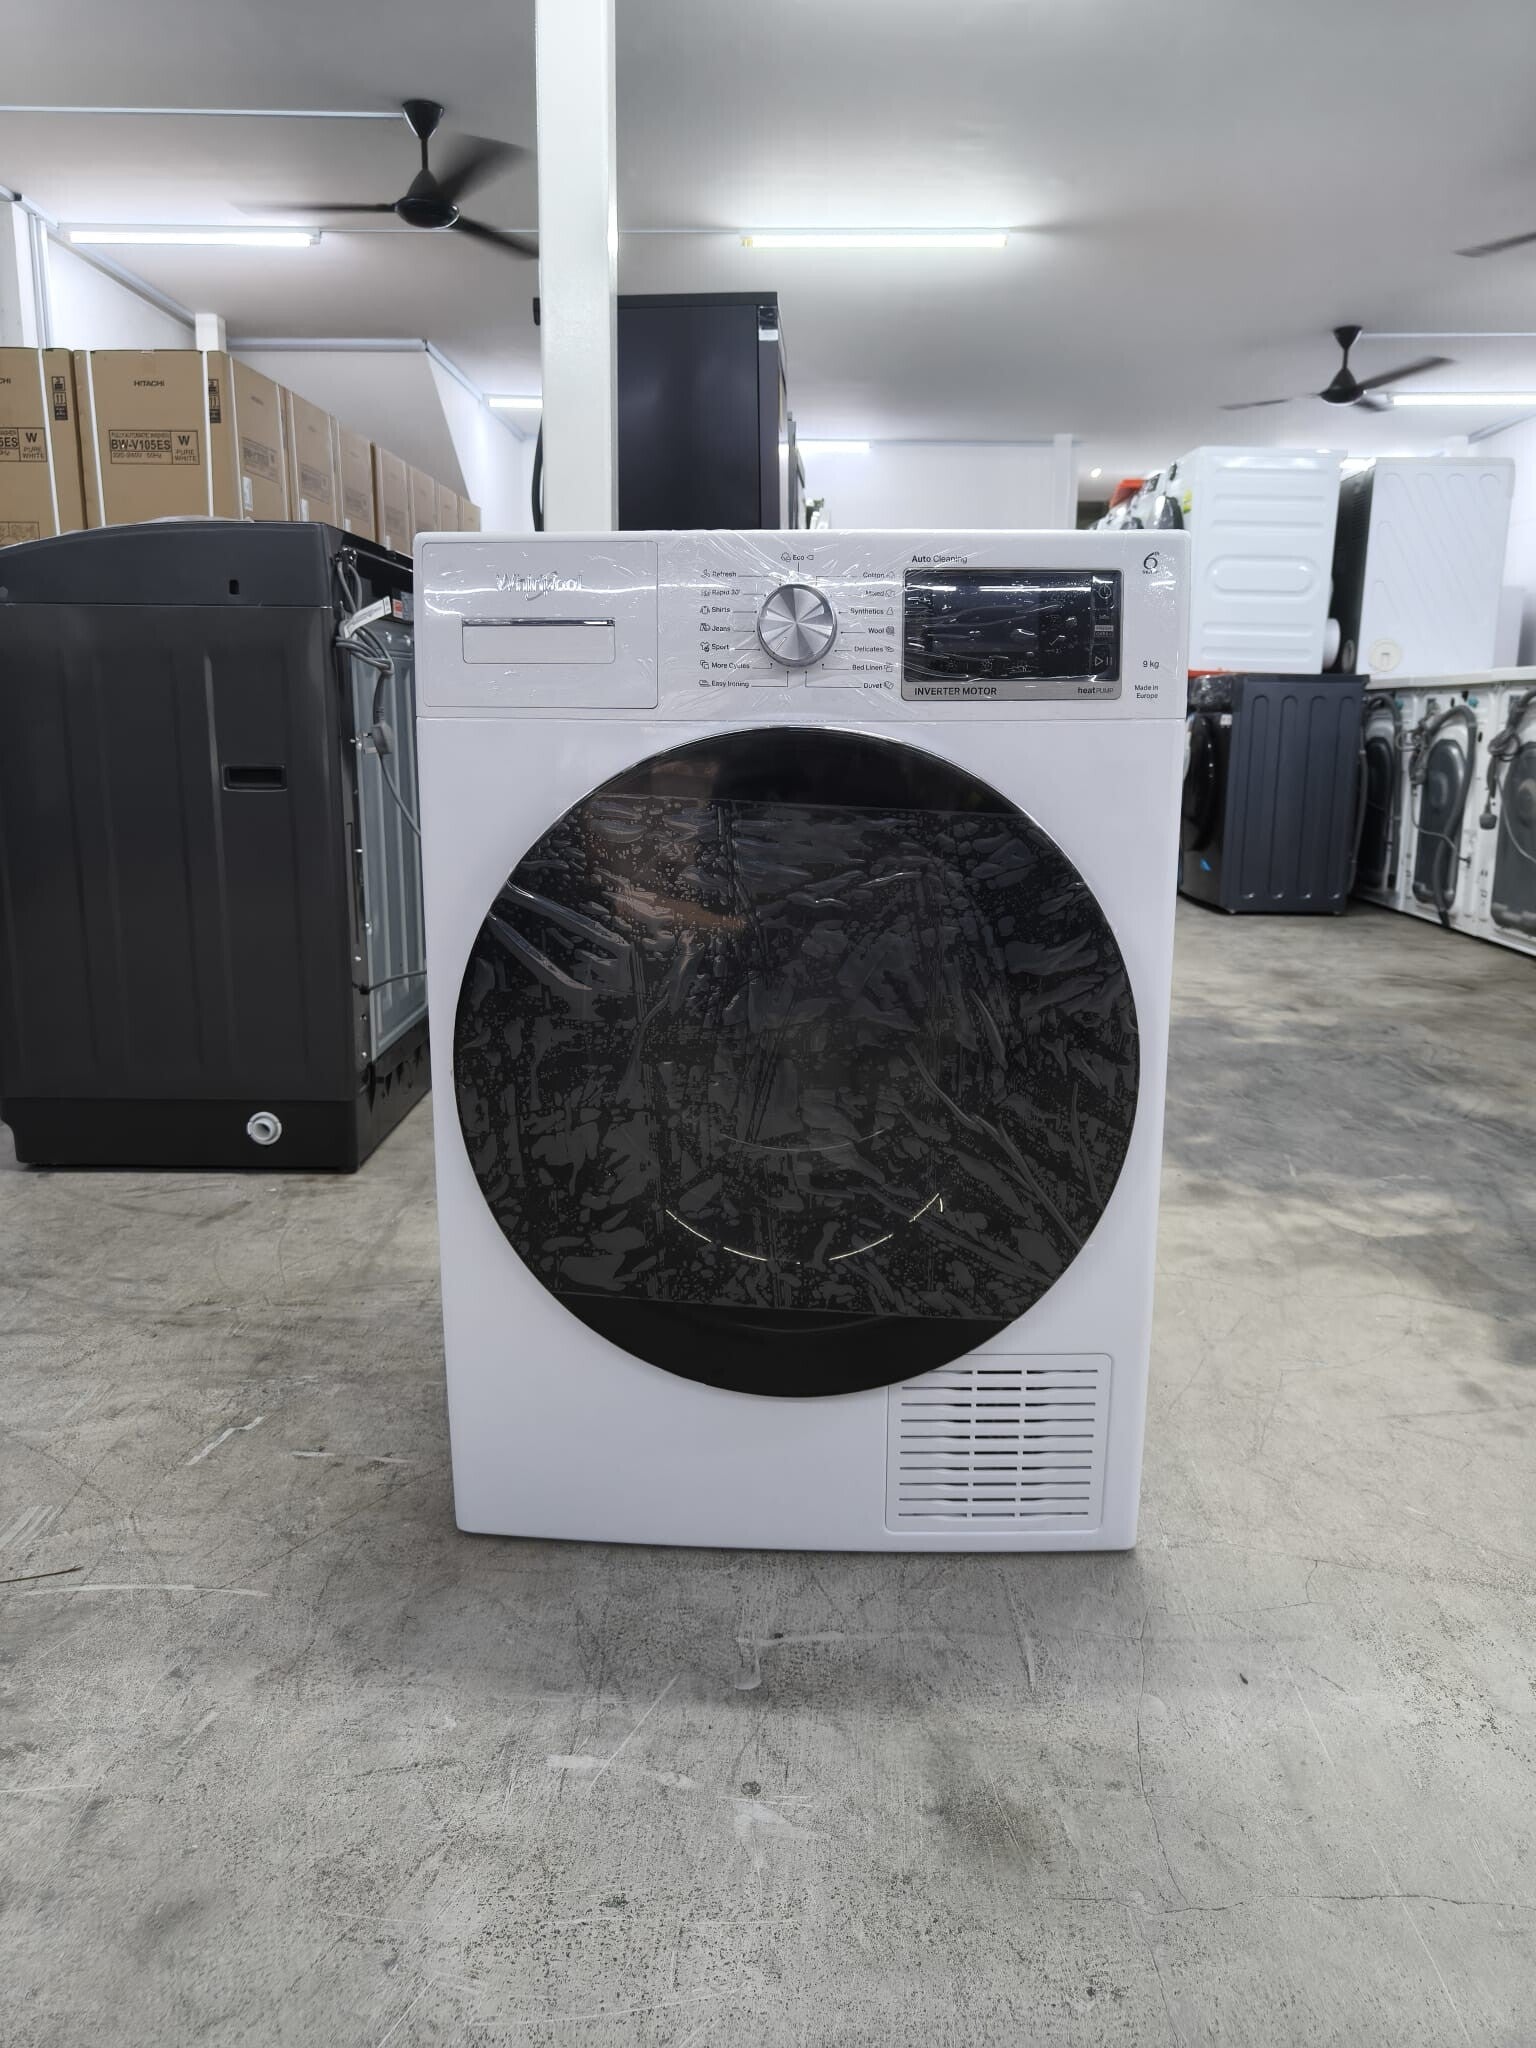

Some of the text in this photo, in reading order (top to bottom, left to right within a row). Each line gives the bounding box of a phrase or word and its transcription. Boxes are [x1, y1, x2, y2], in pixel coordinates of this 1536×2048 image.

[26, 432, 37, 443] W
[178, 435, 190, 446] W
[111, 439, 171, 450] BW-V105ES
[912, 555, 968, 564] Auto Cleaning
[863, 571, 885, 579] Cotton
[712, 643, 729, 651] Sport
[1150, 660, 1160, 670] kg
[712, 680, 727, 688] Easy
[914, 687, 997, 696] INVERTER MOTOR
[1136, 692, 1159, 700] Europe
